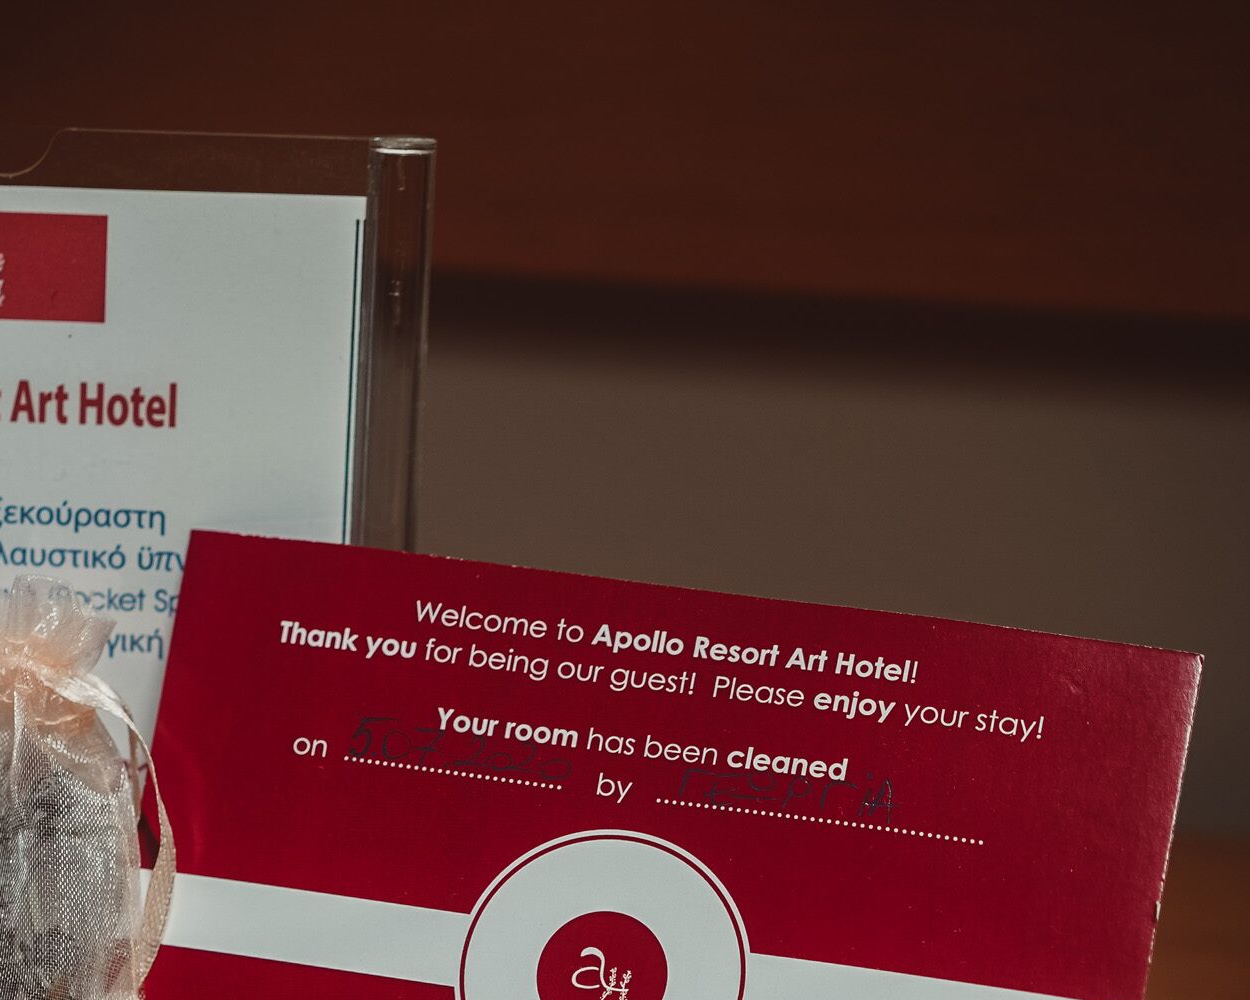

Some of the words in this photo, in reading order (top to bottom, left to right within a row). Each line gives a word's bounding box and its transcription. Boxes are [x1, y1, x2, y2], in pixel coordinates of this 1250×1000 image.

[9, 379, 69, 425] Art
[78, 381, 178, 428] Hotel
[416, 599, 548, 639] Welcome
[557, 618, 584, 643] to
[590, 623, 685, 656] Apollo
[692, 635, 780, 667] Resort
[784, 647, 829, 673] Art
[834, 652, 919, 684] Hotel!
[280, 620, 359, 652] Thank
[365, 635, 418, 659] you
[425, 637, 463, 664] for
[468, 643, 549, 682] being
[557, 661, 605, 683] our
[609, 668, 697, 695] guest!
[712, 675, 805, 708] Please
[813, 690, 897, 724] enjoy
[904, 703, 970, 728] your
[974, 709, 1045, 743] stay!
[292, 737, 328, 758] on
[437, 707, 500, 737] Your
[504, 721, 579, 748] room
[586, 727, 636, 756] has
[643, 734, 718, 766] been
[726, 746, 849, 782] cleaned
[596, 772, 633, 804] by
